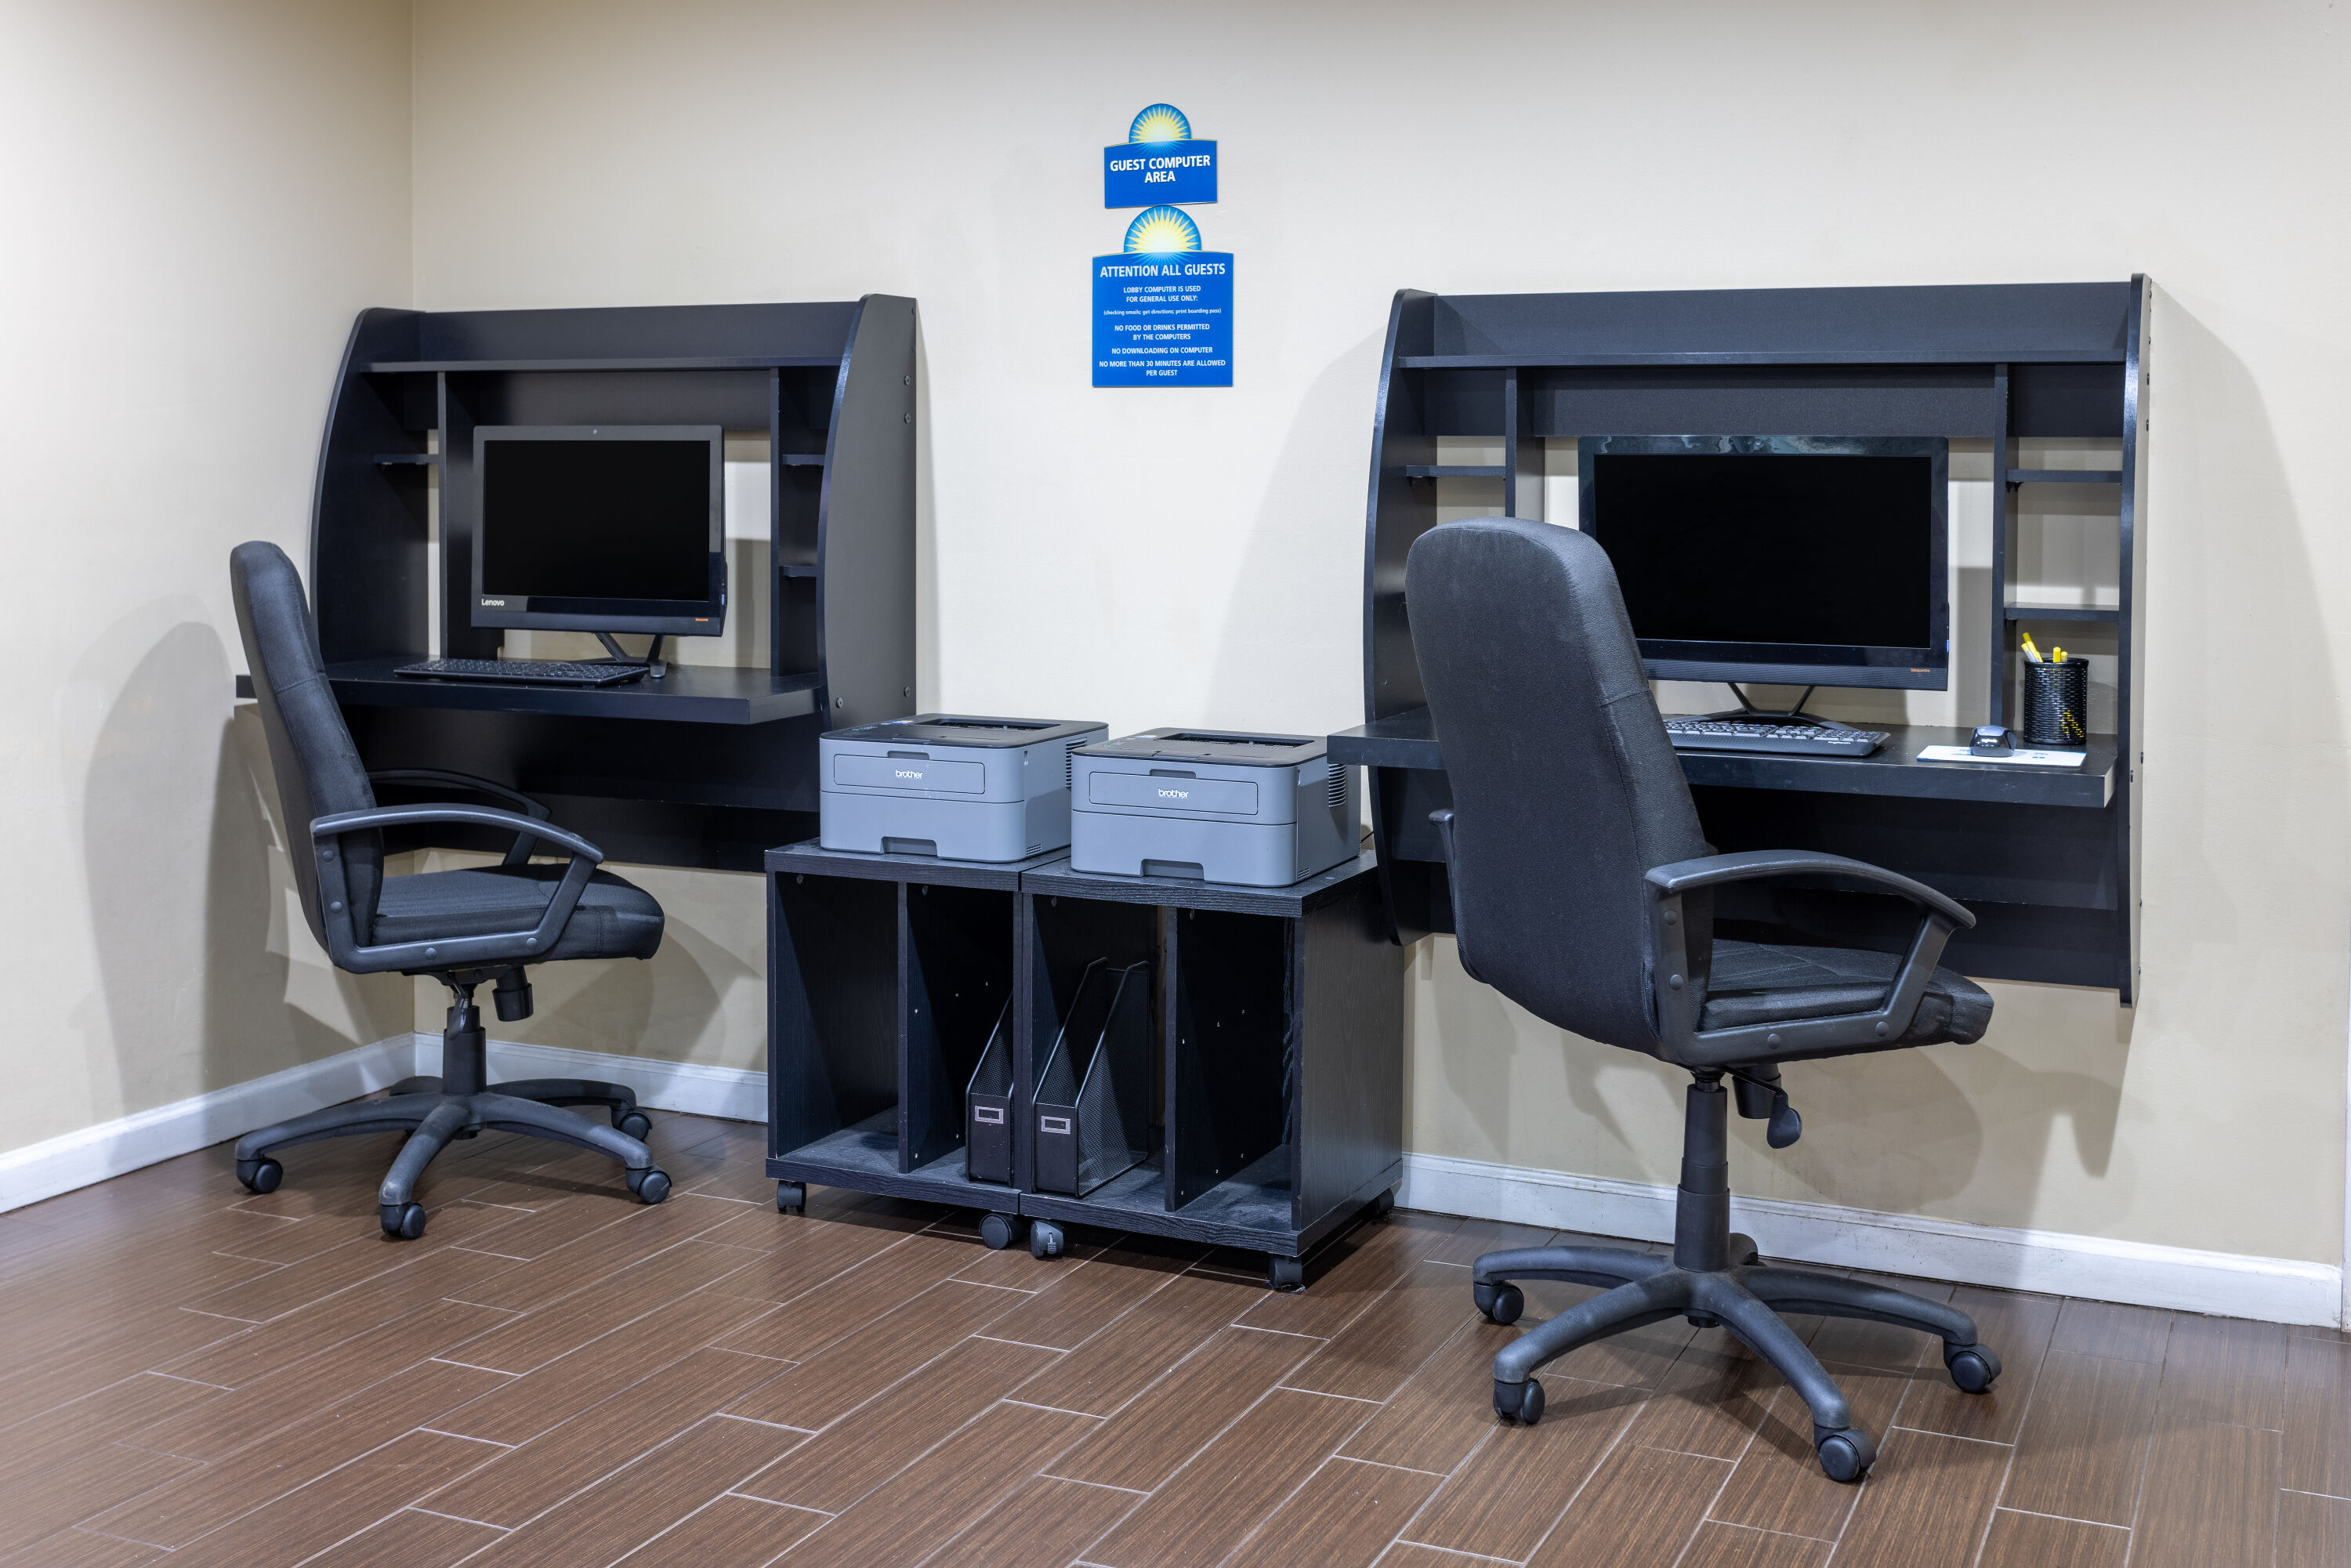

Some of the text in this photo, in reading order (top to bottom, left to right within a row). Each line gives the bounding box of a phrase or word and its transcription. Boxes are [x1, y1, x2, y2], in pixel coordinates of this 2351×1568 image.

[1110, 154, 1211, 172] GUEST COMPUTER
[1144, 170, 1176, 183] AREA
[1099, 263, 1226, 278] ATTENTION ALL GUESTS
[895, 770, 923, 779] brother
[1158, 788, 1189, 798] brother
